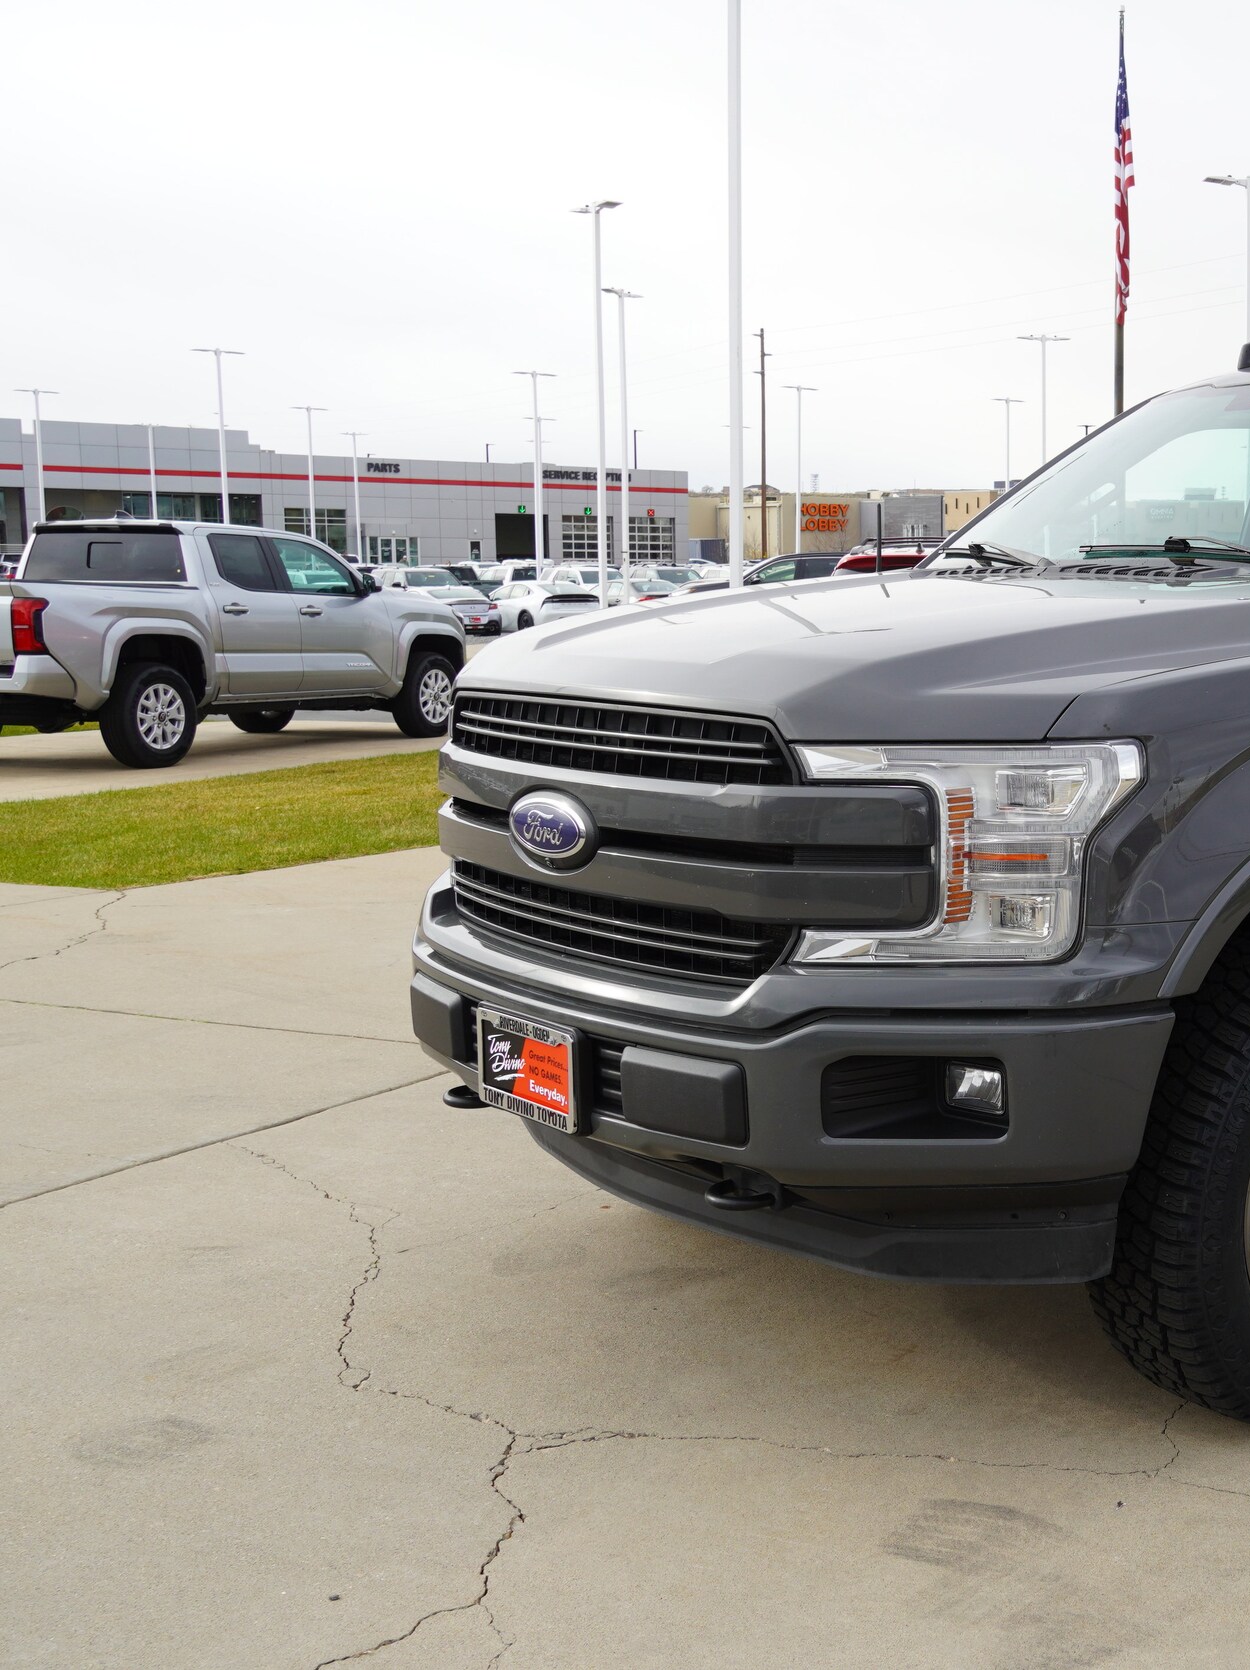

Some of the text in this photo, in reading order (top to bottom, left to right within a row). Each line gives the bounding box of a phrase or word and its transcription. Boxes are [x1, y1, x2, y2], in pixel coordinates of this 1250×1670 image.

[367, 462, 400, 473] PARTS
[542, 470, 580, 480] SERVICE
[523, 809, 564, 846] Ford
[499, 1016, 530, 1037] RIVERDALE
[487, 1033, 512, 1055] Tony
[488, 1053, 527, 1073] Divino
[528, 1050, 546, 1063] Great
[528, 1065, 539, 1077] NO
[529, 1079, 568, 1106] Everyday.
[484, 1087, 568, 1131] TONY DIVINO TOYOTA
